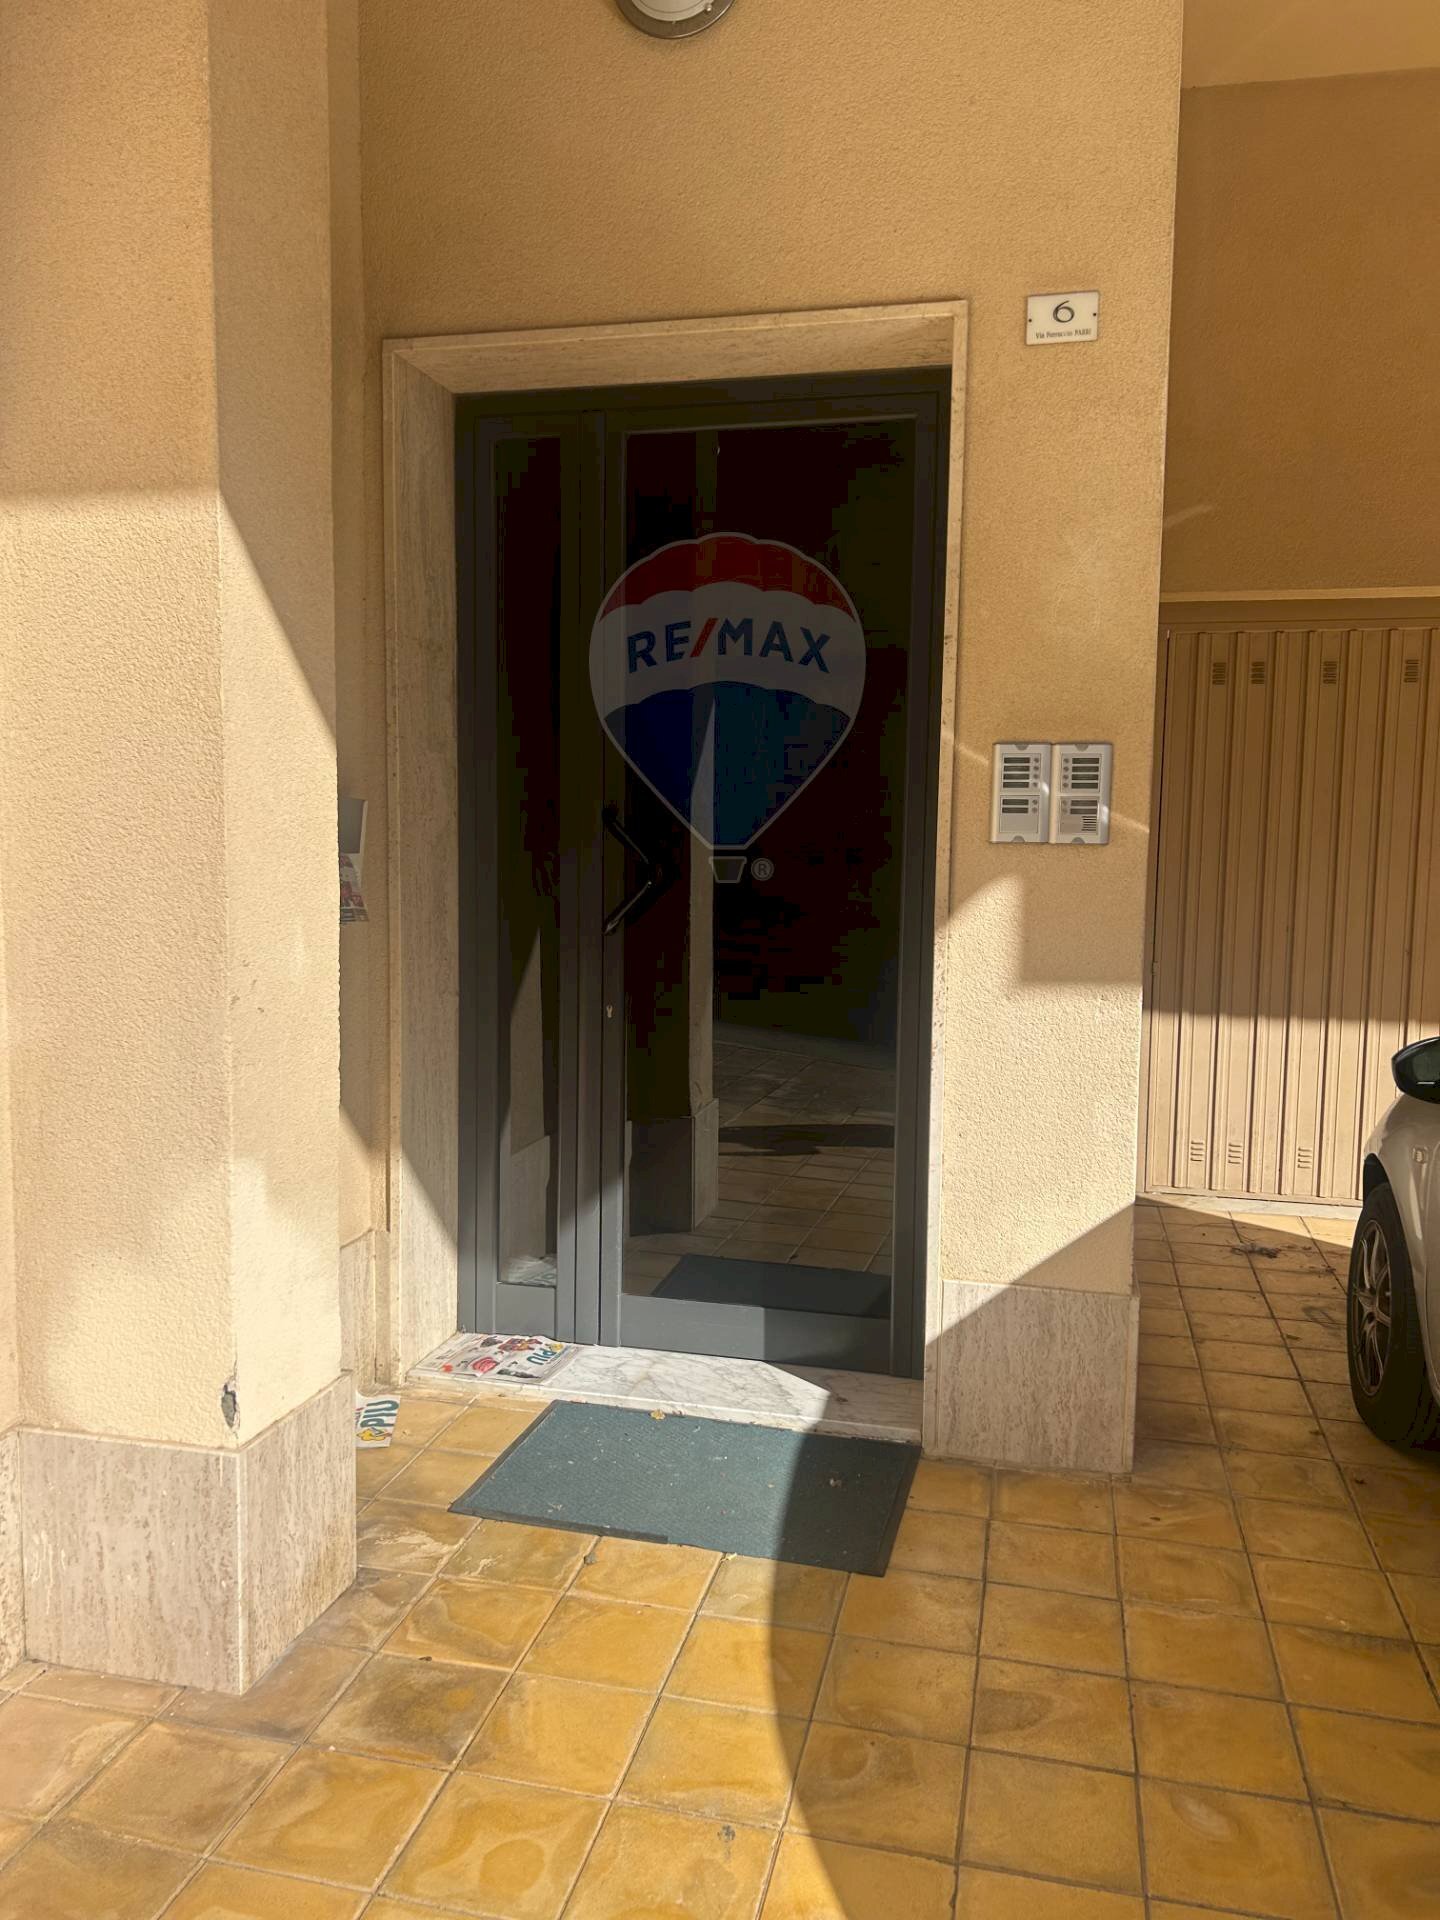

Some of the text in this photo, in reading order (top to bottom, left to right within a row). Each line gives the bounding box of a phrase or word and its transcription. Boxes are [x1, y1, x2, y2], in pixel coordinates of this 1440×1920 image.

[1052, 300, 1075, 323] 6
[1036, 331, 1045, 339] Via
[626, 617, 831, 674] RE/MAX
